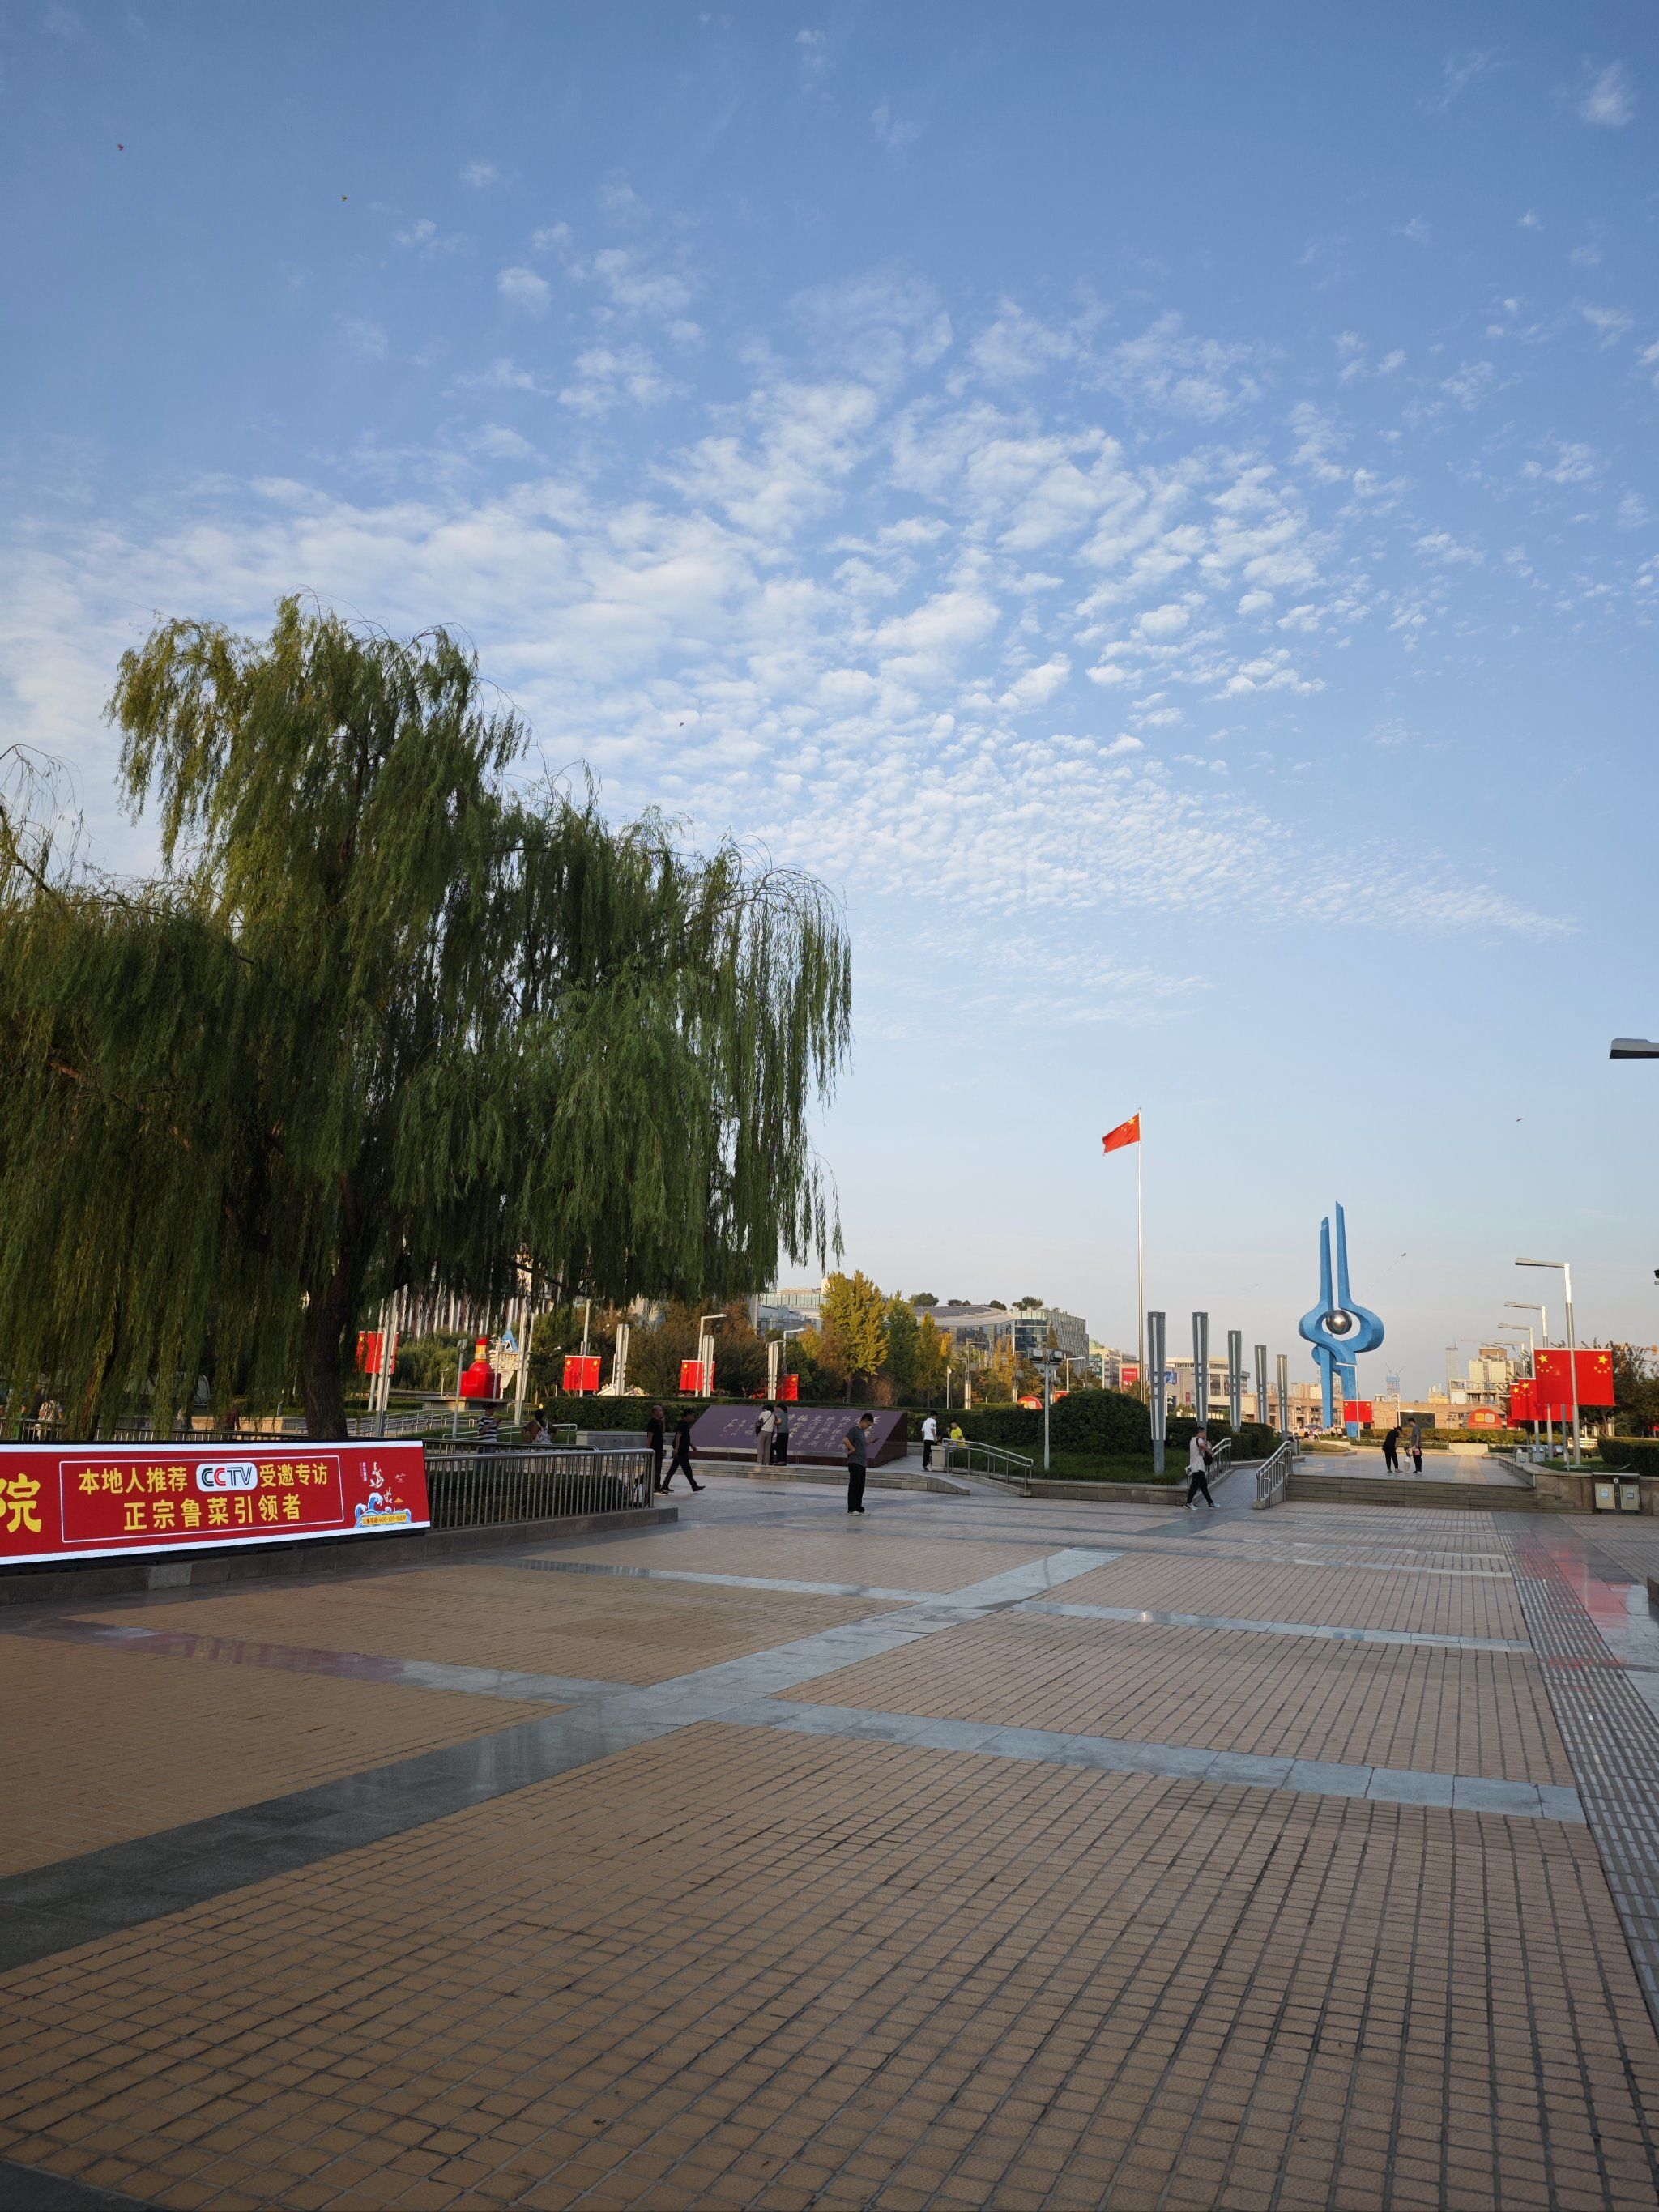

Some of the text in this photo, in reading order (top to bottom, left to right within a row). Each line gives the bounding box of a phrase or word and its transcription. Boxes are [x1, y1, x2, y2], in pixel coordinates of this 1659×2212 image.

[78, 1466, 188, 1495] 本地人推荐
[201, 1466, 253, 1488] CCTV
[259, 1462, 328, 1488] 受邀专访
[123, 1493, 301, 1531] 正宗鲁菜引领者
